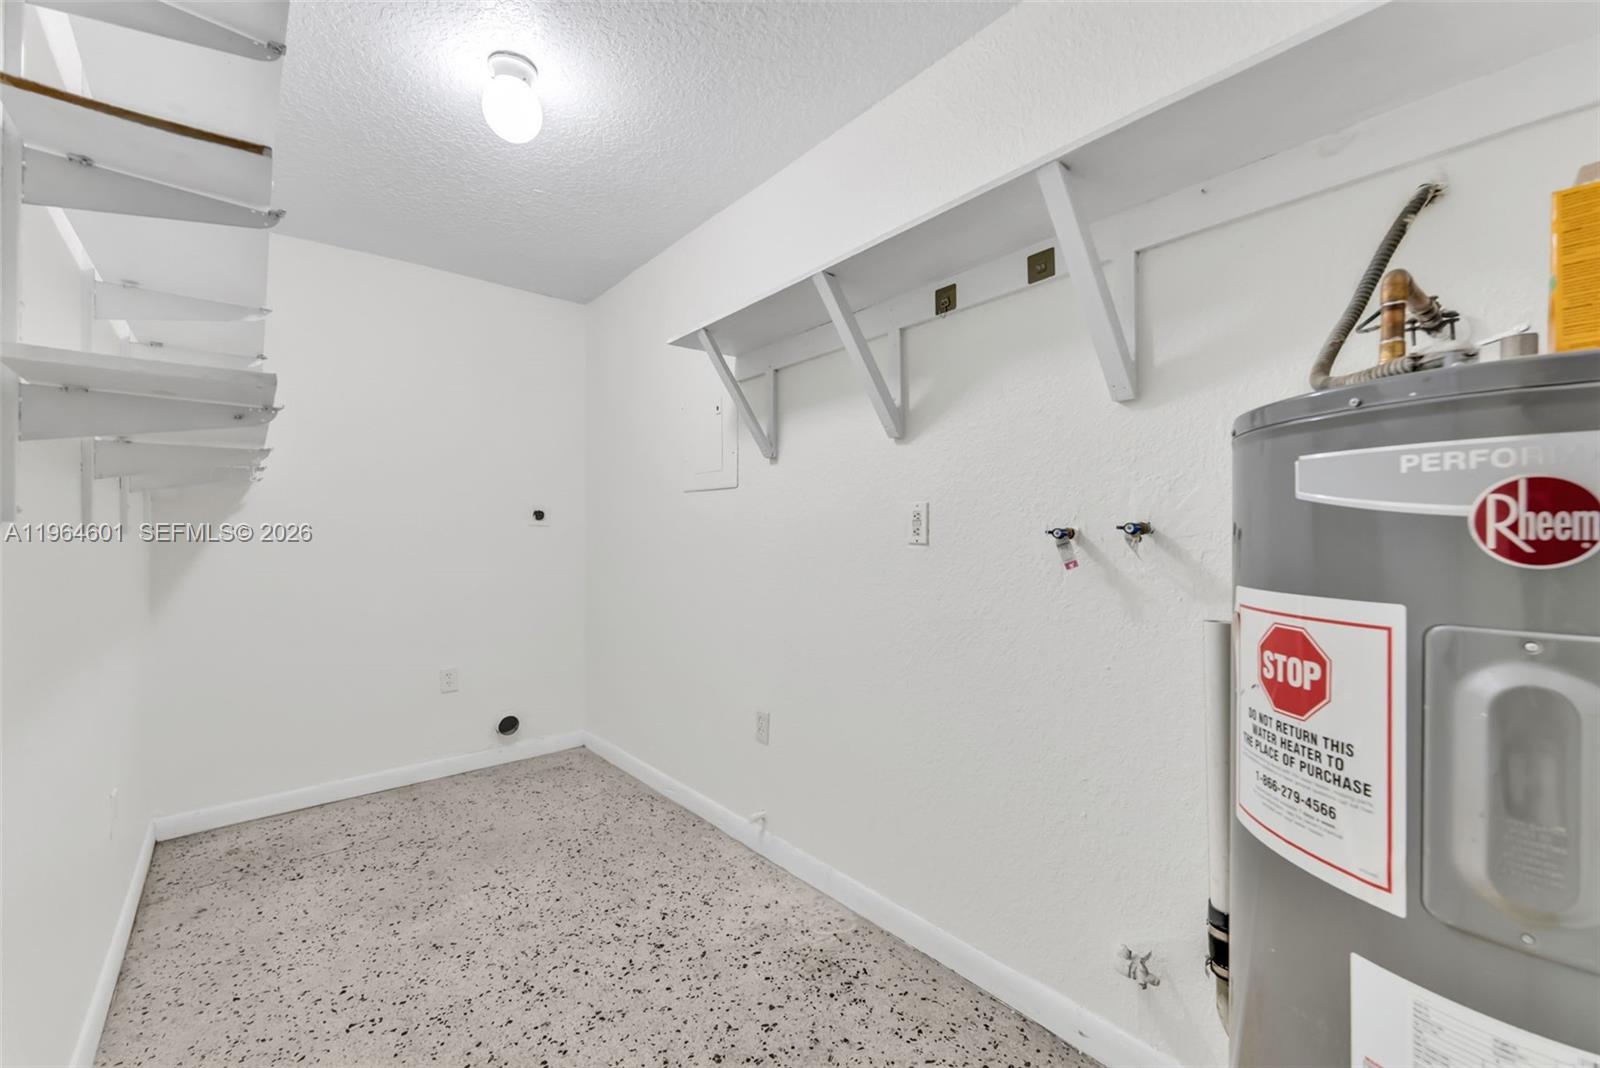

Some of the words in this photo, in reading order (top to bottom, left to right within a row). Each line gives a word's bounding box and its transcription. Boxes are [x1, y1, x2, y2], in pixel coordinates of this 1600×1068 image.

[1486, 478, 1600, 553] Rheem
[1262, 650, 1321, 690] STOP
[1248, 707, 1257, 721] DO
[1259, 712, 1273, 728] NOT
[1276, 719, 1318, 746] RETURN
[1322, 736, 1355, 758] THIS
[1252, 723, 1278, 746] WATER
[1280, 736, 1322, 763] HEATER
[1326, 753, 1345, 771] TO
[1243, 731, 1254, 748] THE
[1255, 739, 1280, 762] PLACE
[1282, 753, 1296, 768] OF
[1299, 760, 1373, 798] PURCHASE
[1255, 770, 1337, 820] 1-866-279-4566
